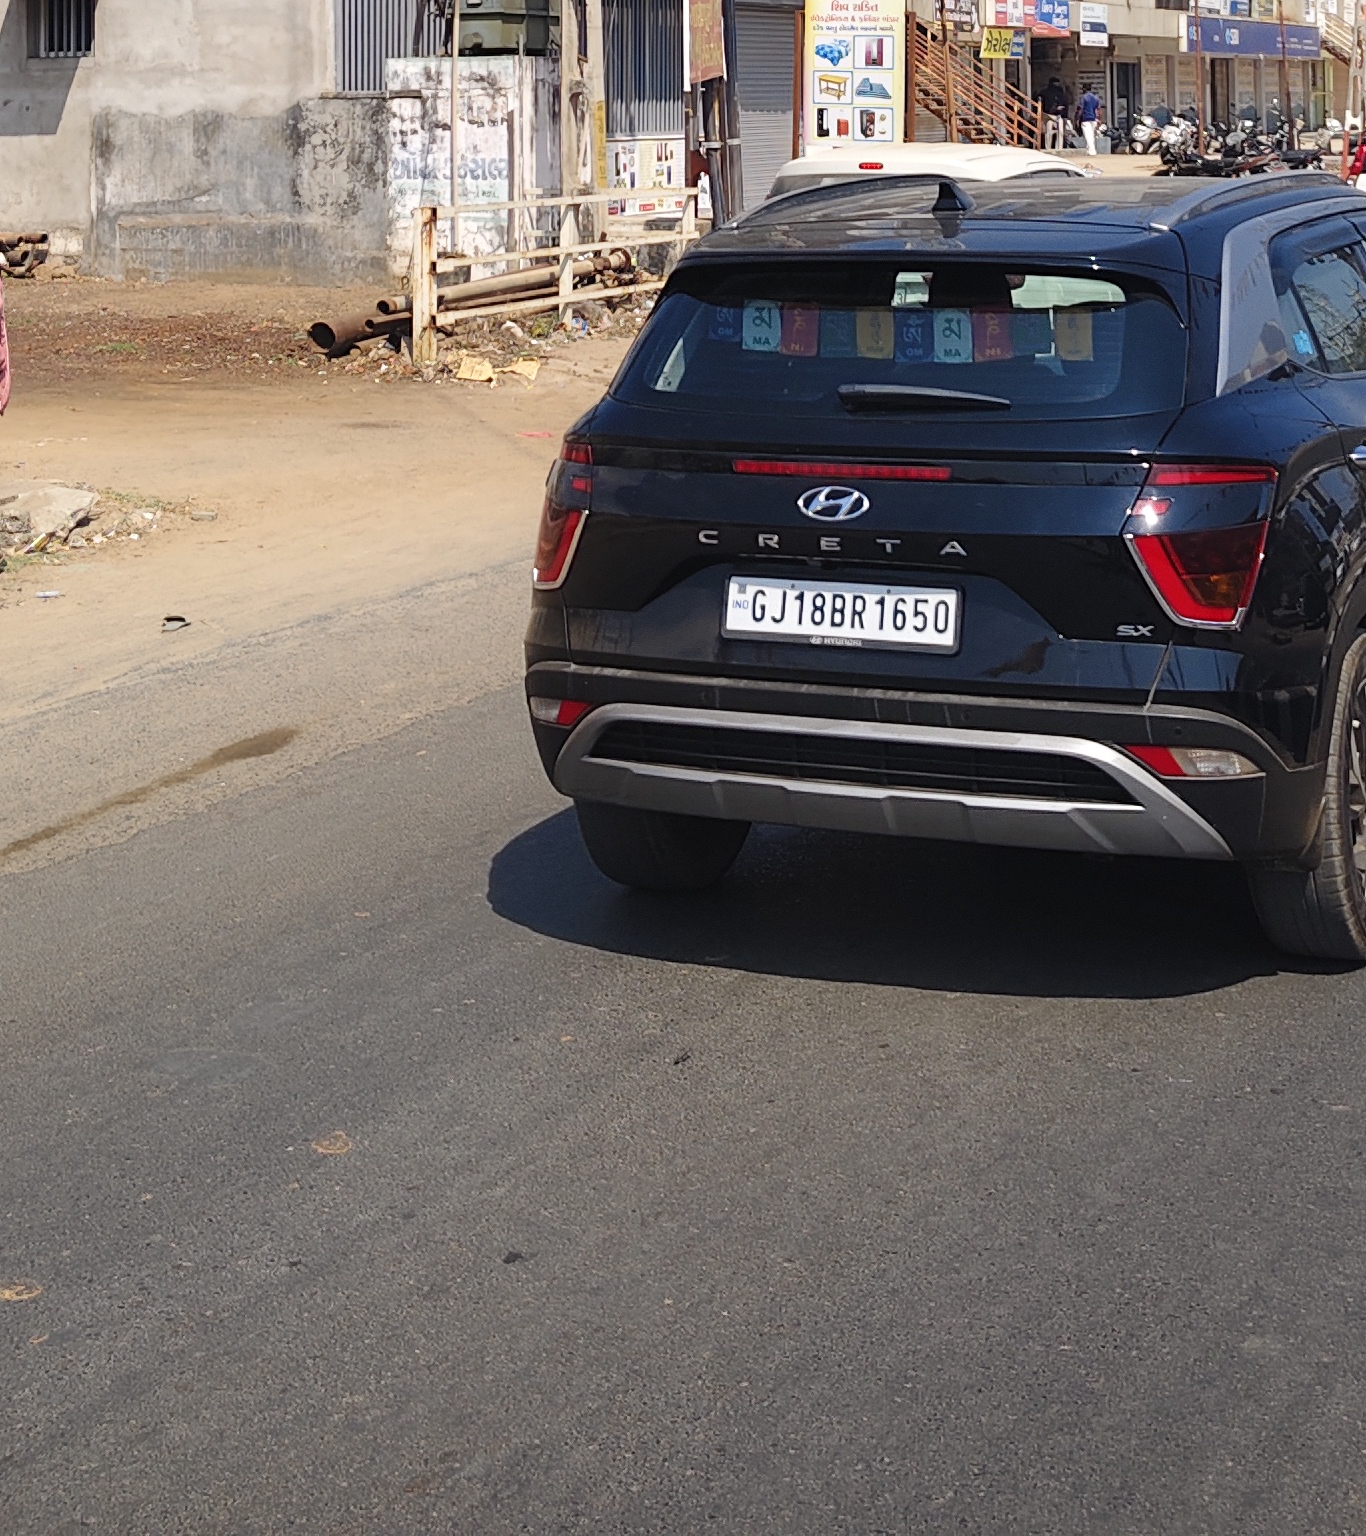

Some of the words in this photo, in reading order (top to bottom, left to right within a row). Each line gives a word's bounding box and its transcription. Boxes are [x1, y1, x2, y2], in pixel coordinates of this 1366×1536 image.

[752, 336, 772, 347] MA
[943, 348, 962, 358] MA
[698, 529, 967, 557] CRETA
[752, 589, 950, 633] GJ18BR1650
[1115, 624, 1154, 639] SX
